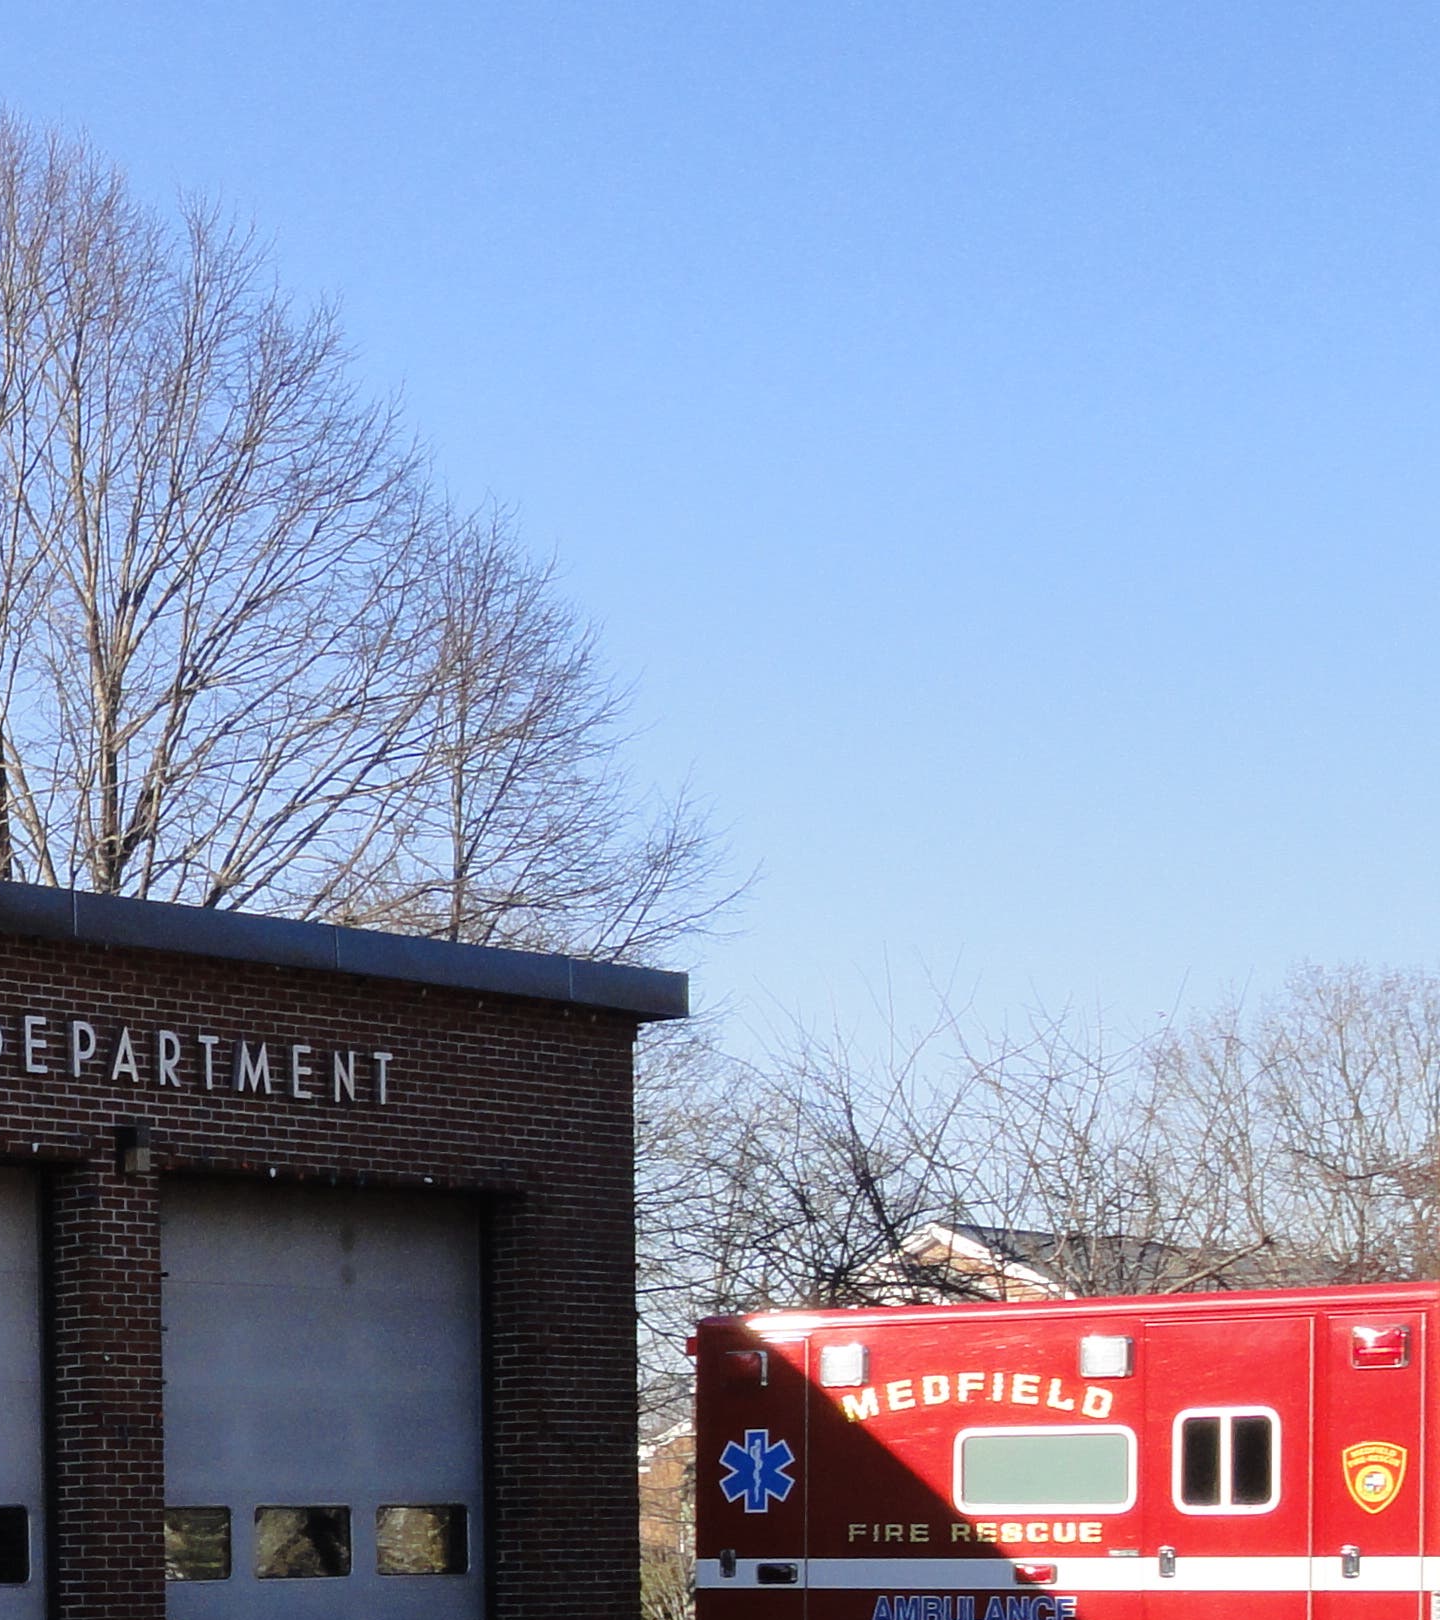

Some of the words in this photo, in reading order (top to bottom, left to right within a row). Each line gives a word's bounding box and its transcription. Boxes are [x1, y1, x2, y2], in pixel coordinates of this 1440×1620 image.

[842, 1372, 1113, 1422] MEDFIELD
[848, 1523, 930, 1542] FIRE
[951, 1522, 1103, 1543] RESCUE
